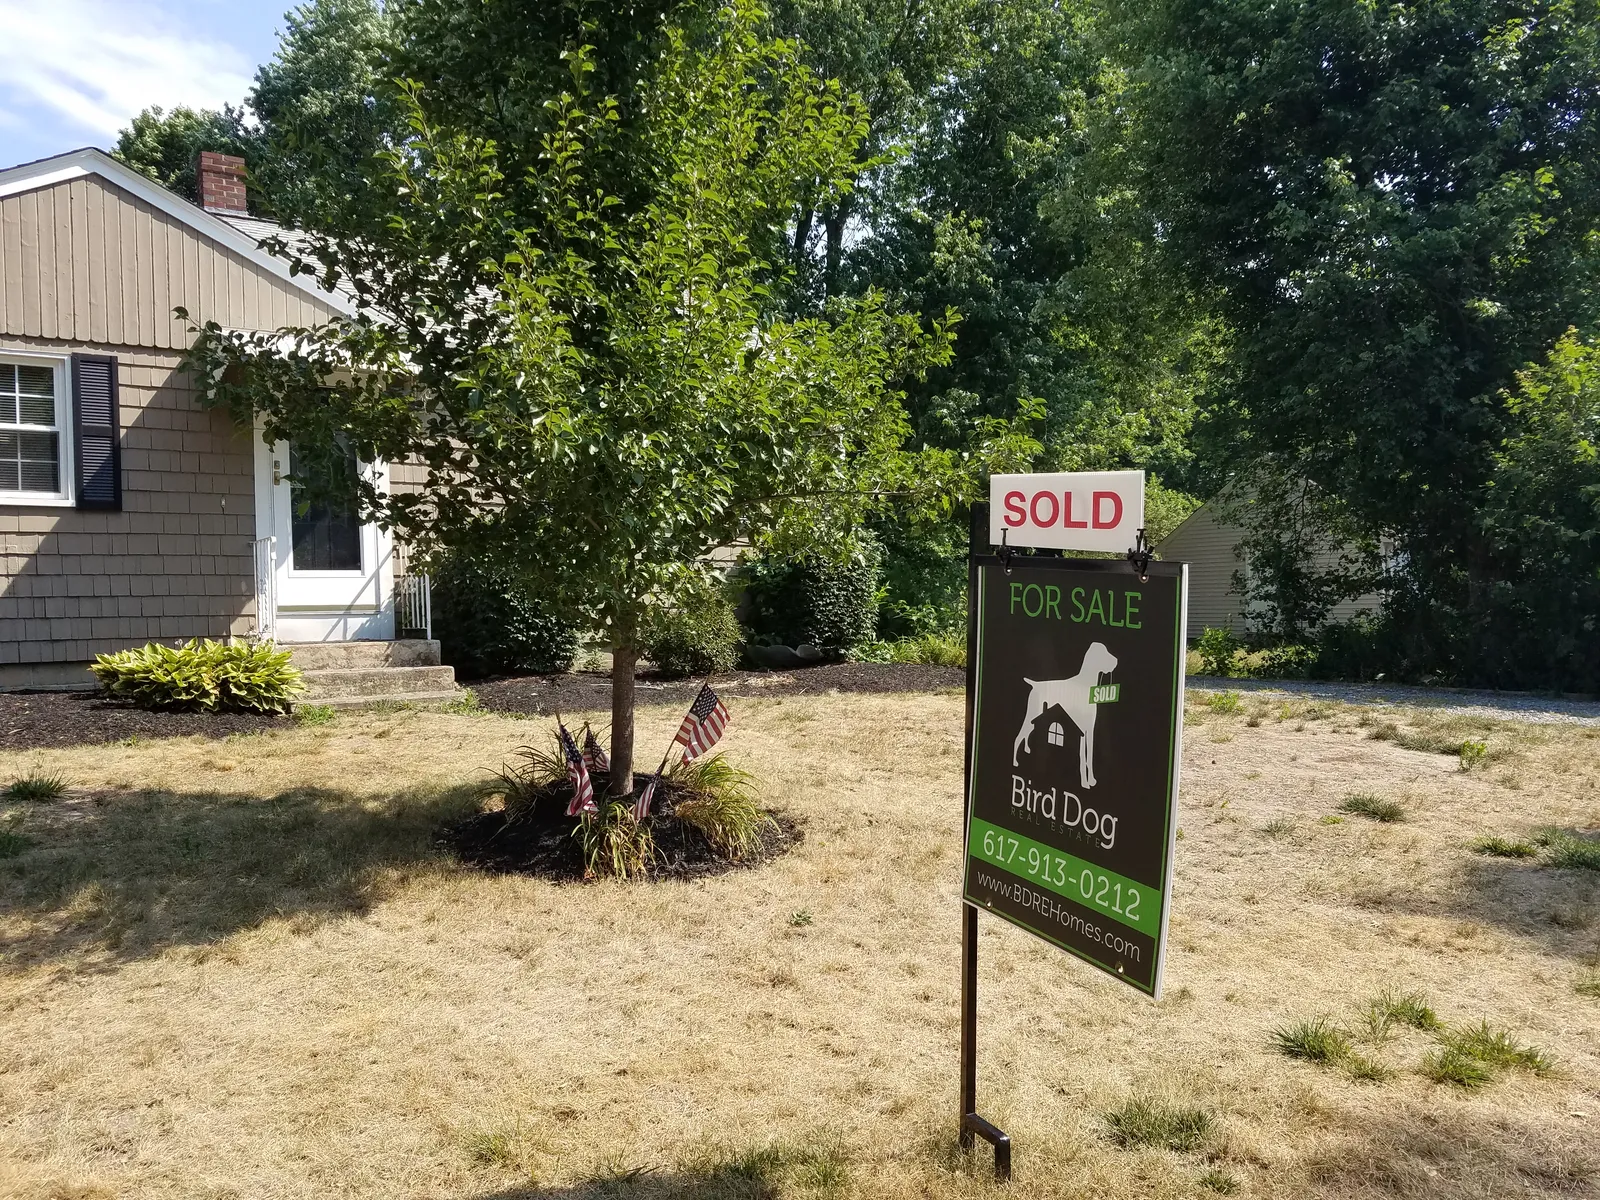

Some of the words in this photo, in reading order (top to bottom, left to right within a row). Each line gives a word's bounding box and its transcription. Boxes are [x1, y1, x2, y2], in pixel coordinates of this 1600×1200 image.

[1003, 490, 1123, 529] SOLD
[1009, 582, 1062, 620] FOR
[1070, 587, 1142, 629] SALE
[1093, 686, 1117, 703] SOLD
[1011, 774, 1057, 820] Bird
[1063, 791, 1119, 849] Dog
[1011, 807, 1040, 826] REAL
[1051, 821, 1101, 848] ESTATE
[983, 830, 1141, 921] 617-913-0212
[977, 871, 1141, 962] www.BDREHomes.com
